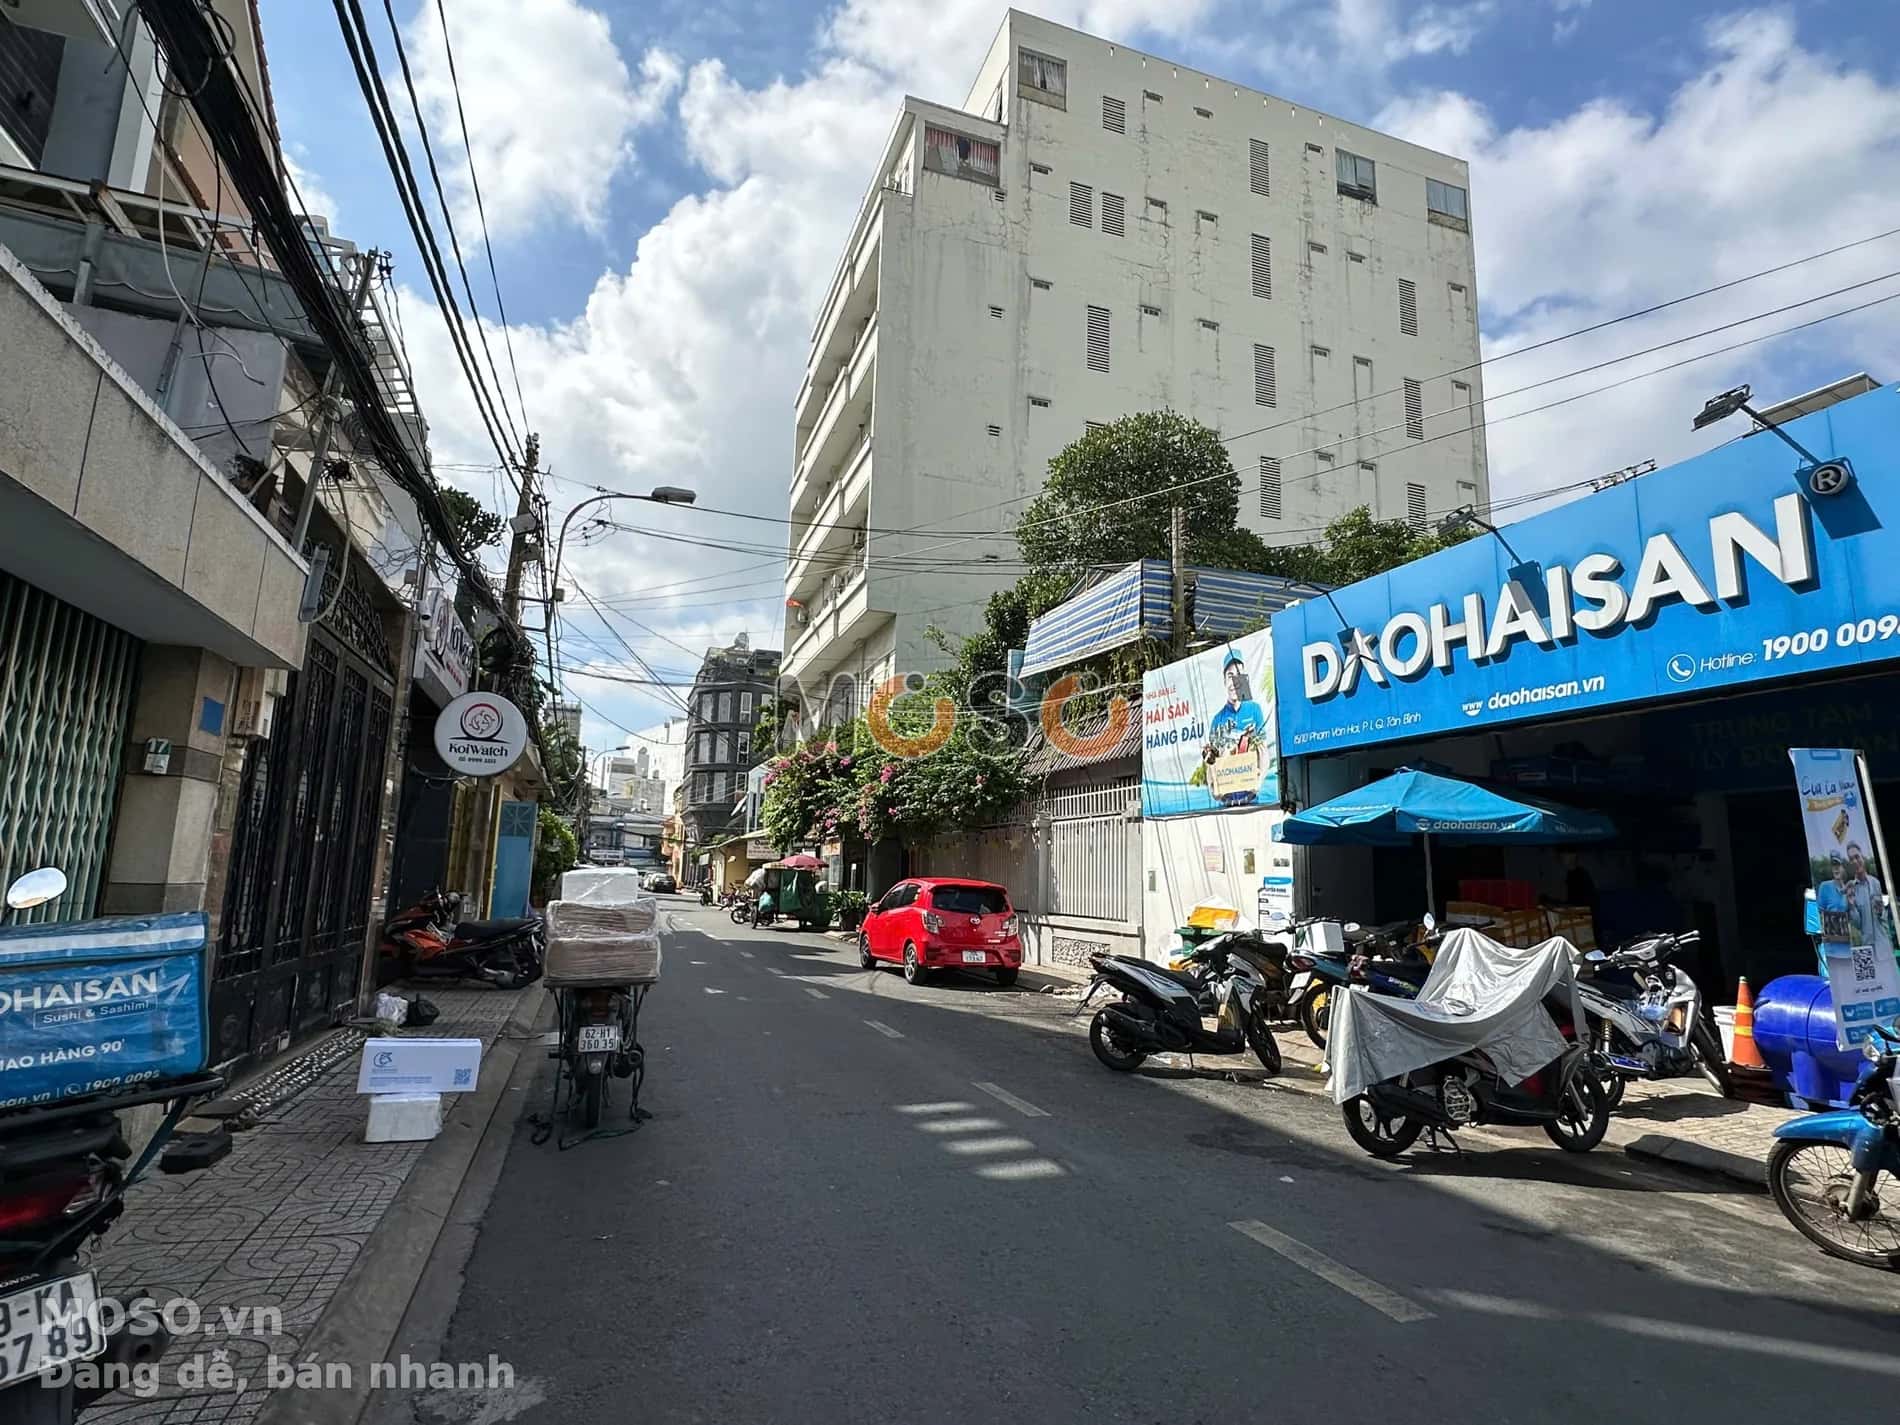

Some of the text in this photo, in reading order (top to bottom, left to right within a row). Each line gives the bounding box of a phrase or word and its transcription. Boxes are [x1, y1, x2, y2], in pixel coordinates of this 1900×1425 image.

[1302, 492, 1813, 699] DAOHAISAN
[1700, 615, 1900, 673] Hotline: 1900 009
[1487, 675, 1605, 710] daohaisan.vn
[146, 737, 169, 753] 17
[1146, 716, 1205, 750] HÀNG ĐẦU
[449, 743, 508, 757] KoiWatch
[43, 1012, 81, 1024] Sushi
[86, 1008, 95, 1018] &
[41, 1043, 96, 1064] HÀNG
